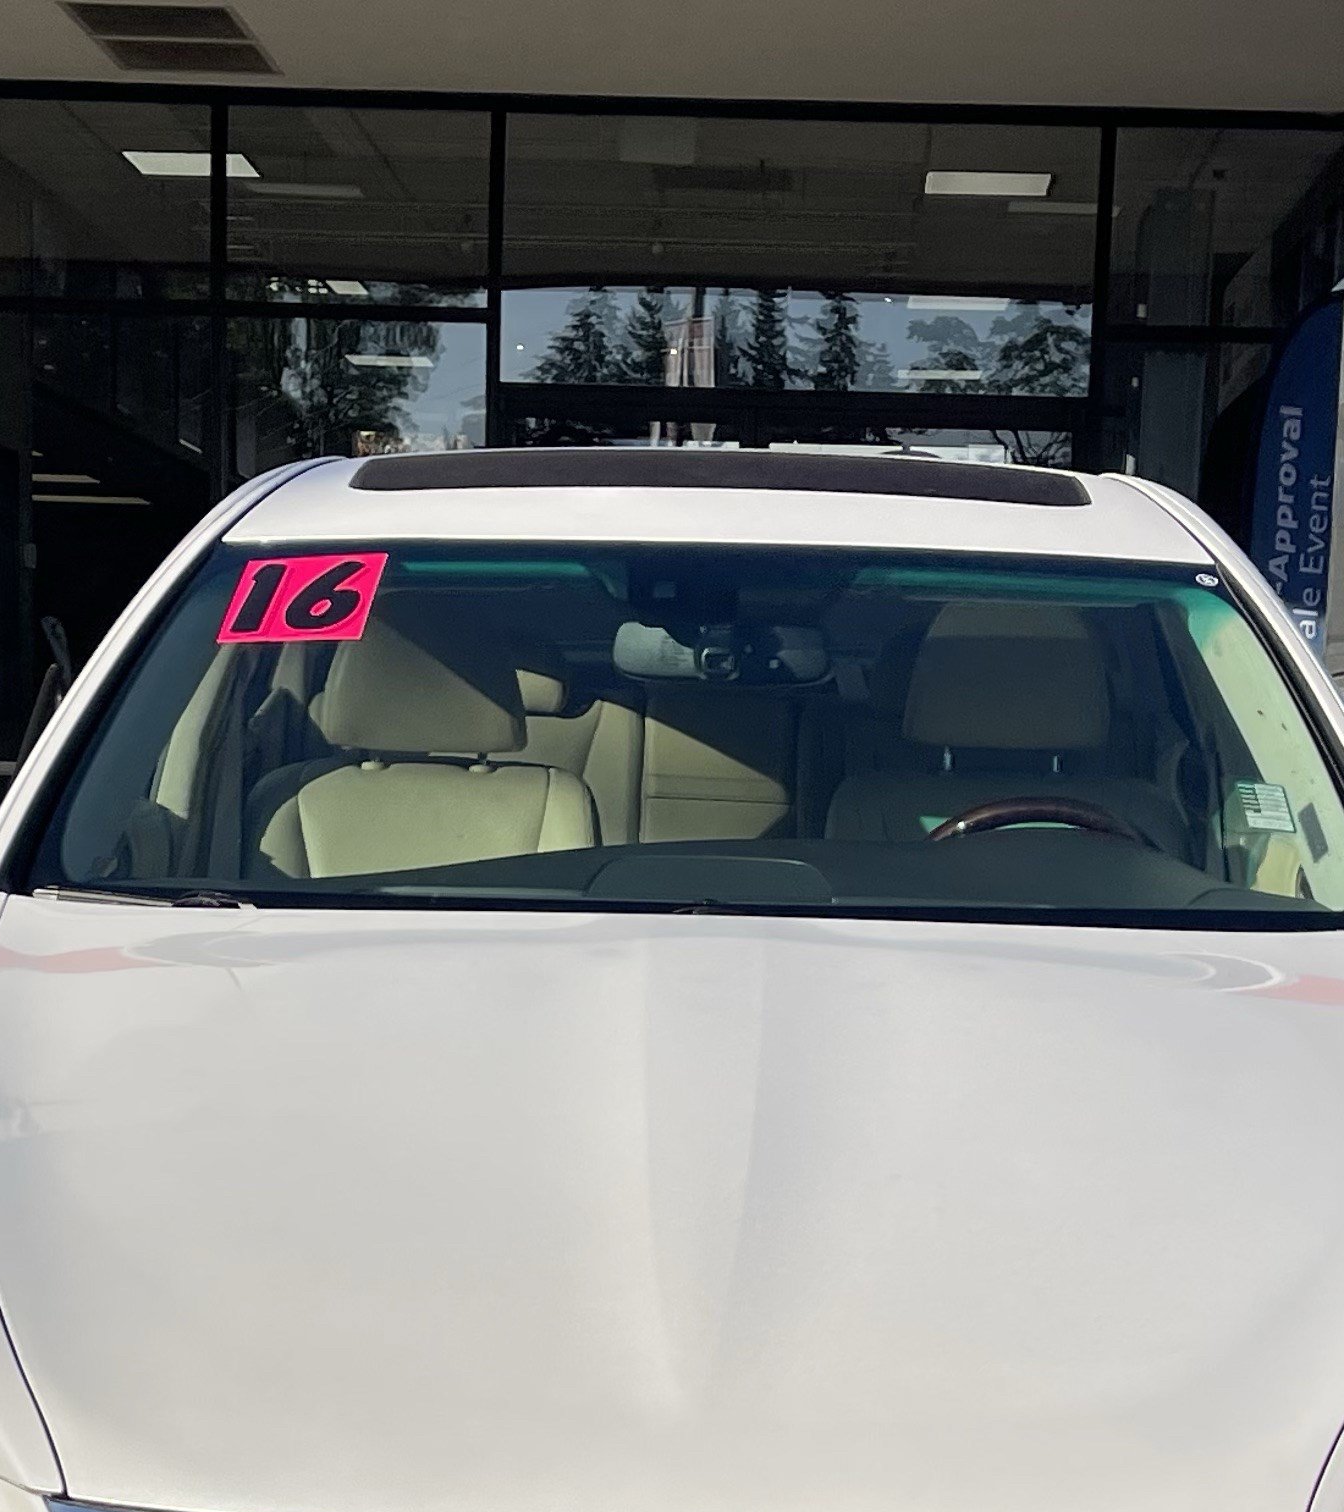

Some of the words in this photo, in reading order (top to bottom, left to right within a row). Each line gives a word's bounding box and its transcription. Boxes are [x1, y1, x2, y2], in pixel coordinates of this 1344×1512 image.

[1299, 473, 1332, 575] Event
[230, 561, 367, 631] 16
[1292, 586, 1322, 640] ale
